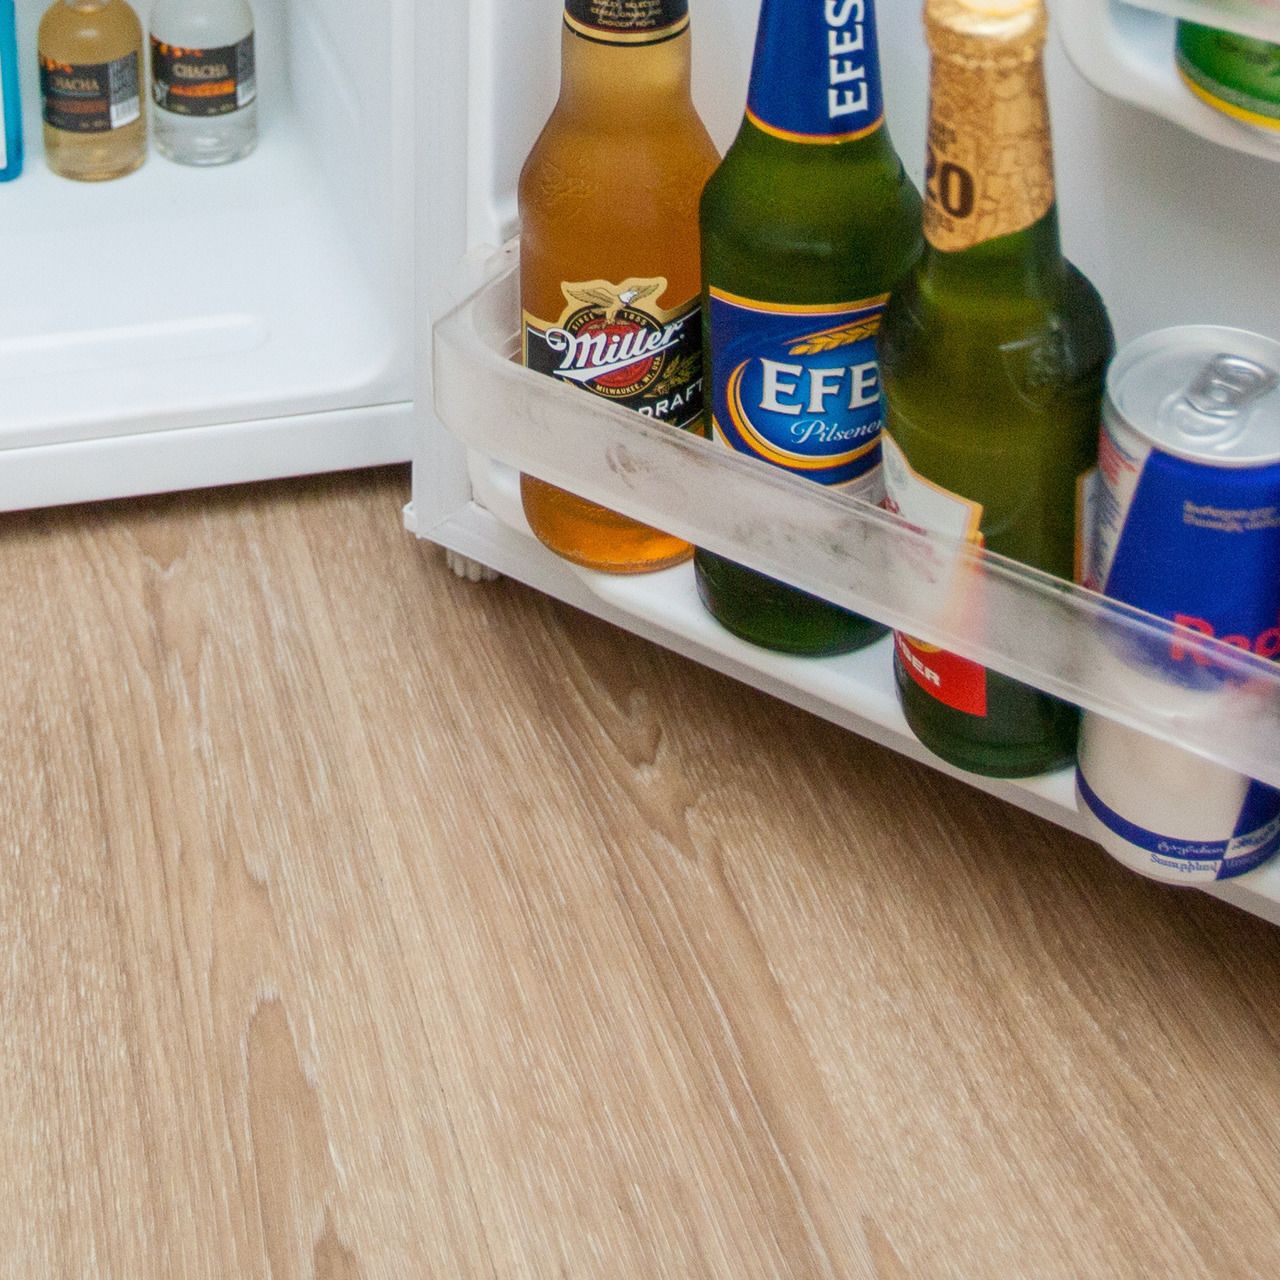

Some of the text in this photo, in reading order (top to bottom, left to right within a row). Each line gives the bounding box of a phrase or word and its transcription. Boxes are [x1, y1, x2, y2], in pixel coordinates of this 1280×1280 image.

[546, 321, 684, 370] Miller
[572, 312, 595, 330] SINCE
[759, 358, 881, 415] EFE
